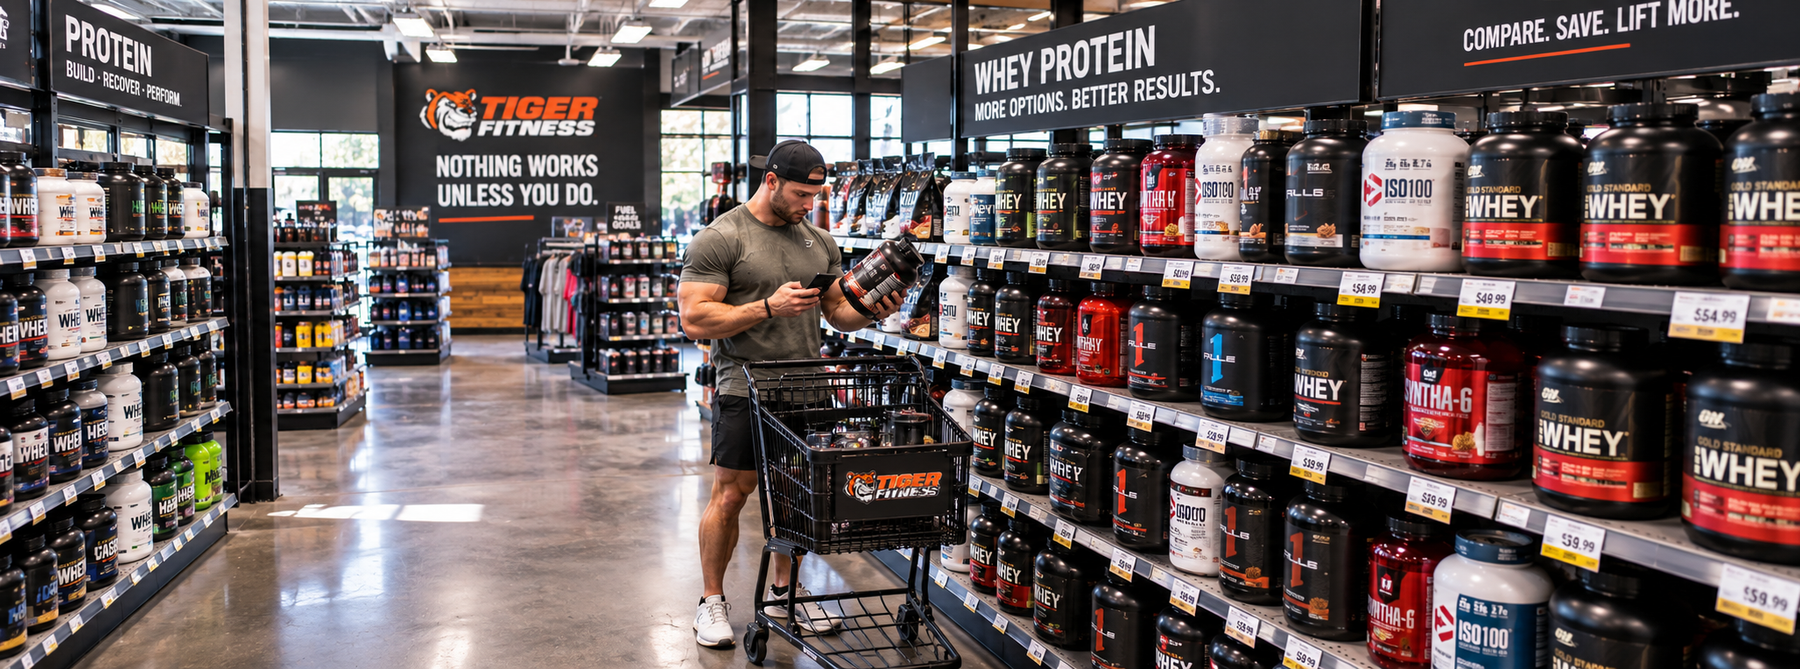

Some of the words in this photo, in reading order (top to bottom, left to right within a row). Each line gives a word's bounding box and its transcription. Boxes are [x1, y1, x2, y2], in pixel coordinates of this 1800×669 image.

[1463, 18, 1550, 53] COMPARE.
[1556, 10, 1609, 40] SAVE.
[1617, 2, 1661, 33] LIFT
[1667, 0, 1740, 26] MORE.
[65, 14, 153, 78] PROTEIN
[975, 51, 1034, 95] WHEY
[1040, 25, 1156, 84] PROTEIN
[66, 60, 95, 84] BUILD
[103, 71, 141, 97] RECOVER
[146, 84, 183, 108] PERFORM.
[975, 98, 1006, 122] MORE
[1009, 90, 1068, 119] OPTIONS.
[1072, 82, 1128, 110] BETTER
[1134, 69, 1221, 102] RESULTS.
[480, 96, 599, 120] TIGER
[477, 120, 596, 137] FITNESS
[436, 155, 523, 178] NOTHING
[527, 154, 599, 177] WORKS
[438, 183, 515, 207] UNLESS
[519, 183, 560, 206] YOU
[566, 183, 599, 206] DO.
[1384, 178, 1432, 198] ISO100
[1481, 186, 1521, 194] STANDARD
[1603, 183, 1652, 193] STANDARD
[1754, 180, 1800, 191] STANDA
[615, 206, 637, 214] FUEL
[1090, 192, 1127, 210] WHEY
[1469, 195, 1538, 218] WHEY
[1589, 193, 1671, 219] WHEY
[1693, 308, 1737, 324] $54.99
[1294, 373, 1343, 401] WHEY
[1405, 377, 1472, 413] SYNTHA-6
[1558, 414, 1605, 428] STANDARD
[1543, 420, 1625, 456] WHEY
[1723, 440, 1783, 459] STANDARD
[876, 472, 942, 489] TIGER
[1700, 447, 1800, 492] WHEY
[876, 485, 940, 499] FITNESS
[1458, 618, 1509, 650] ISO100
